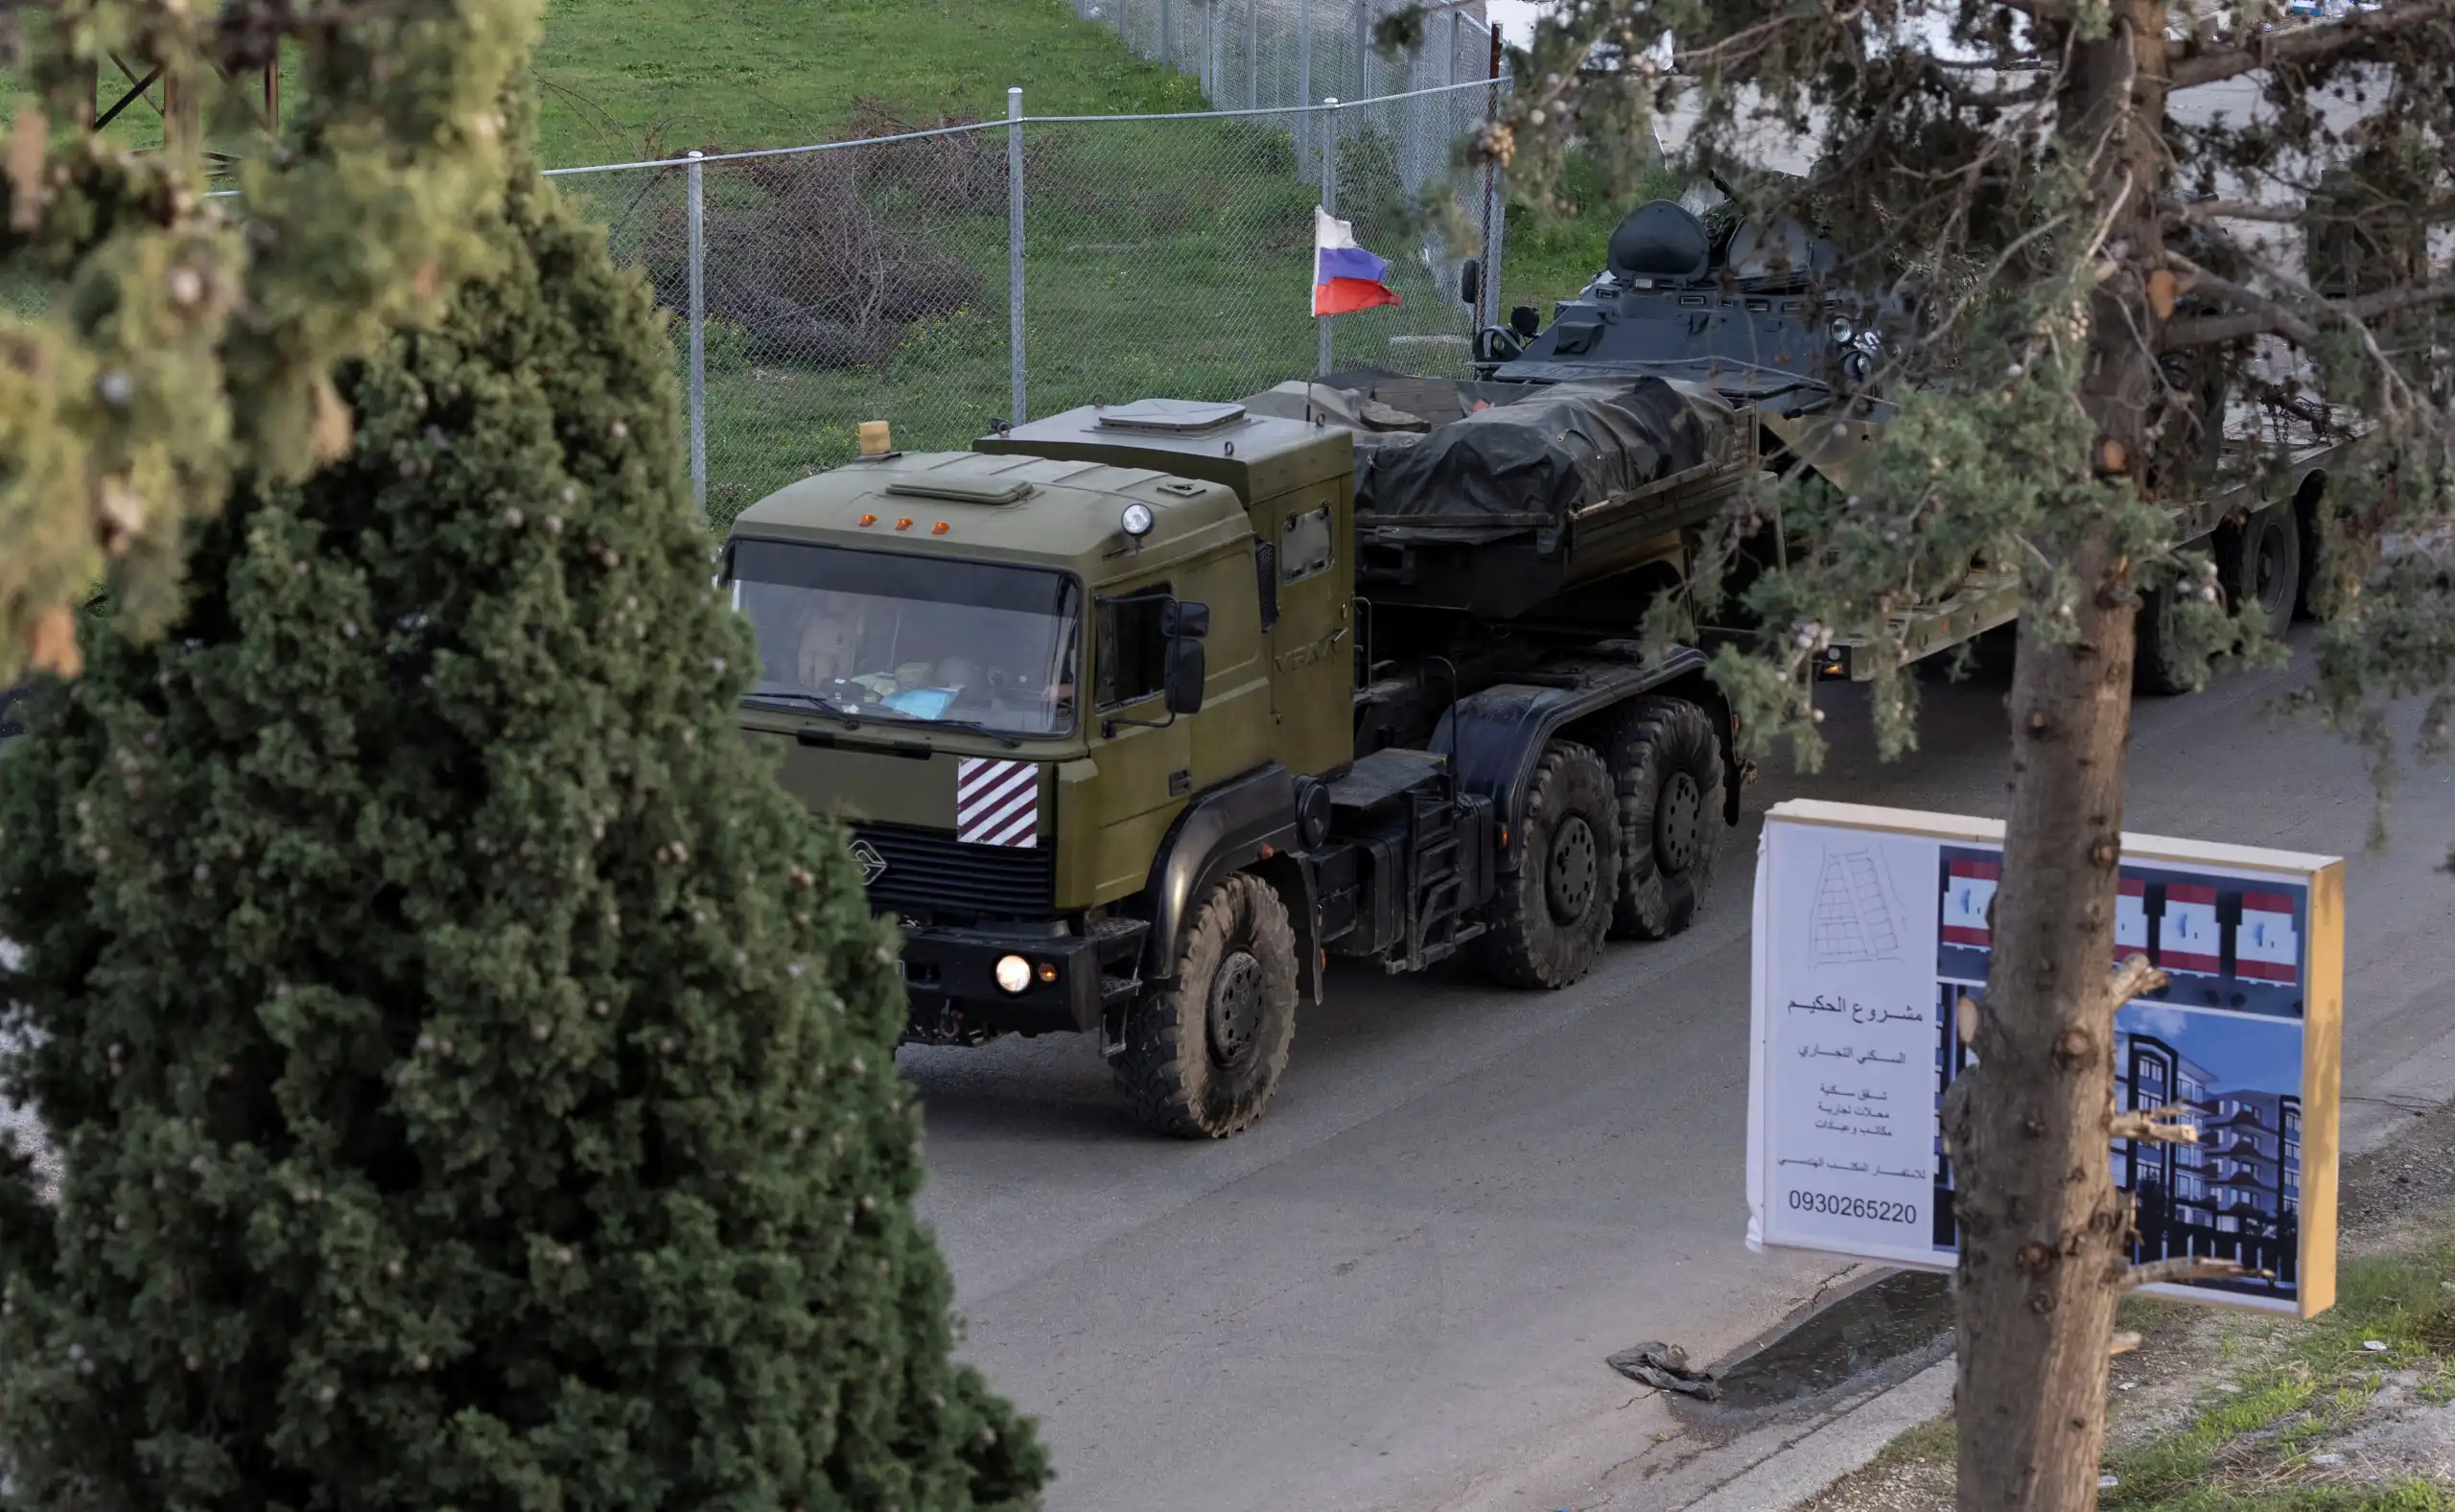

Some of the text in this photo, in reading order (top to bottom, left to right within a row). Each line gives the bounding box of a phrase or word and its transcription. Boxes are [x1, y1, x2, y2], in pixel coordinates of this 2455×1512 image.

[1788, 995, 1923, 1024] مشروع الحكيم
[1798, 1043, 1906, 1064] السكني التجاري
[1817, 1101, 1890, 1119] محلات تجارية
[1789, 1190, 1917, 1224] 0930265220
